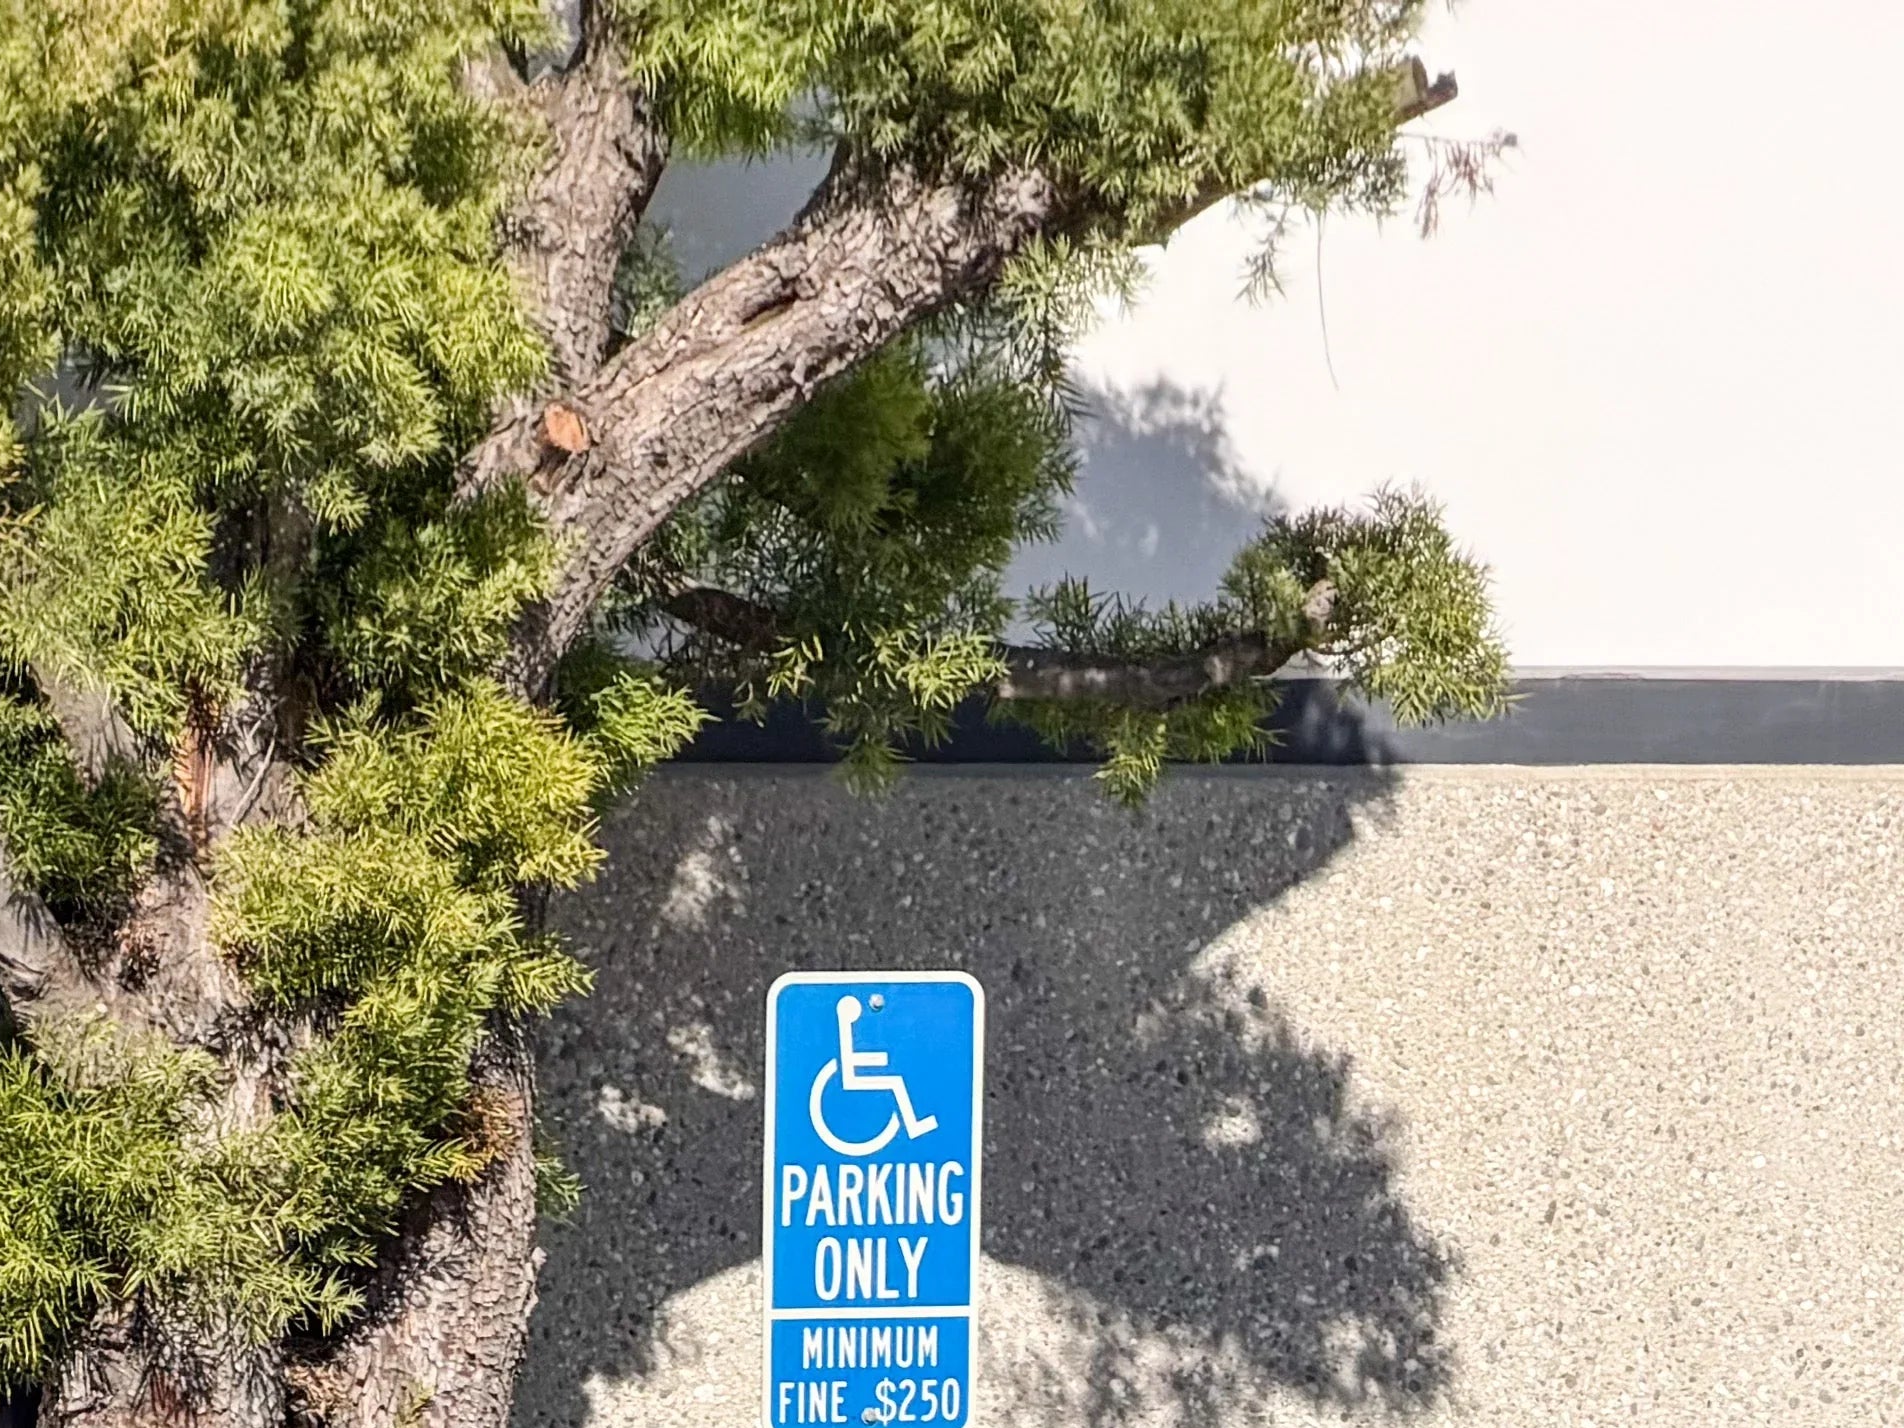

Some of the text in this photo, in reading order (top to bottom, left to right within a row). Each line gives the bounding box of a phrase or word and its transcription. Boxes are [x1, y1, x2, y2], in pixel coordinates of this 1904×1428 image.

[781, 1160, 964, 1227] PARKING
[814, 1236, 929, 1302] ONLY
[802, 1325, 938, 1370] MINIMUM
[778, 1377, 961, 1428] FINE $250
